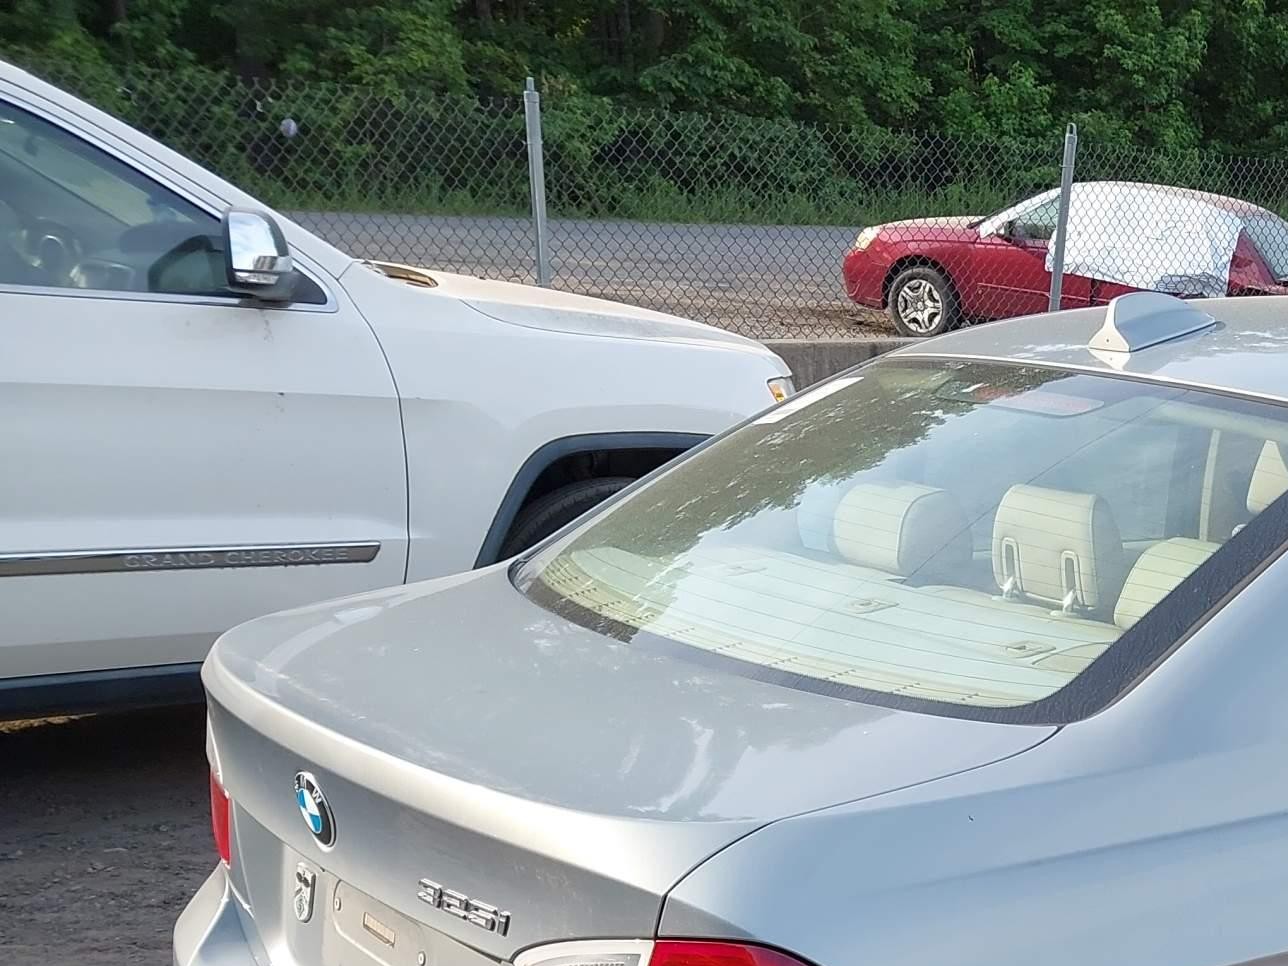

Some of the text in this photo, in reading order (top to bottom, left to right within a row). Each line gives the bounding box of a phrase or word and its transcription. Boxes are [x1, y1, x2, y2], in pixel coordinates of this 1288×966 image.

[123, 548, 350, 568] GRAND CHEROKEE
[416, 877, 512, 938] 325i
